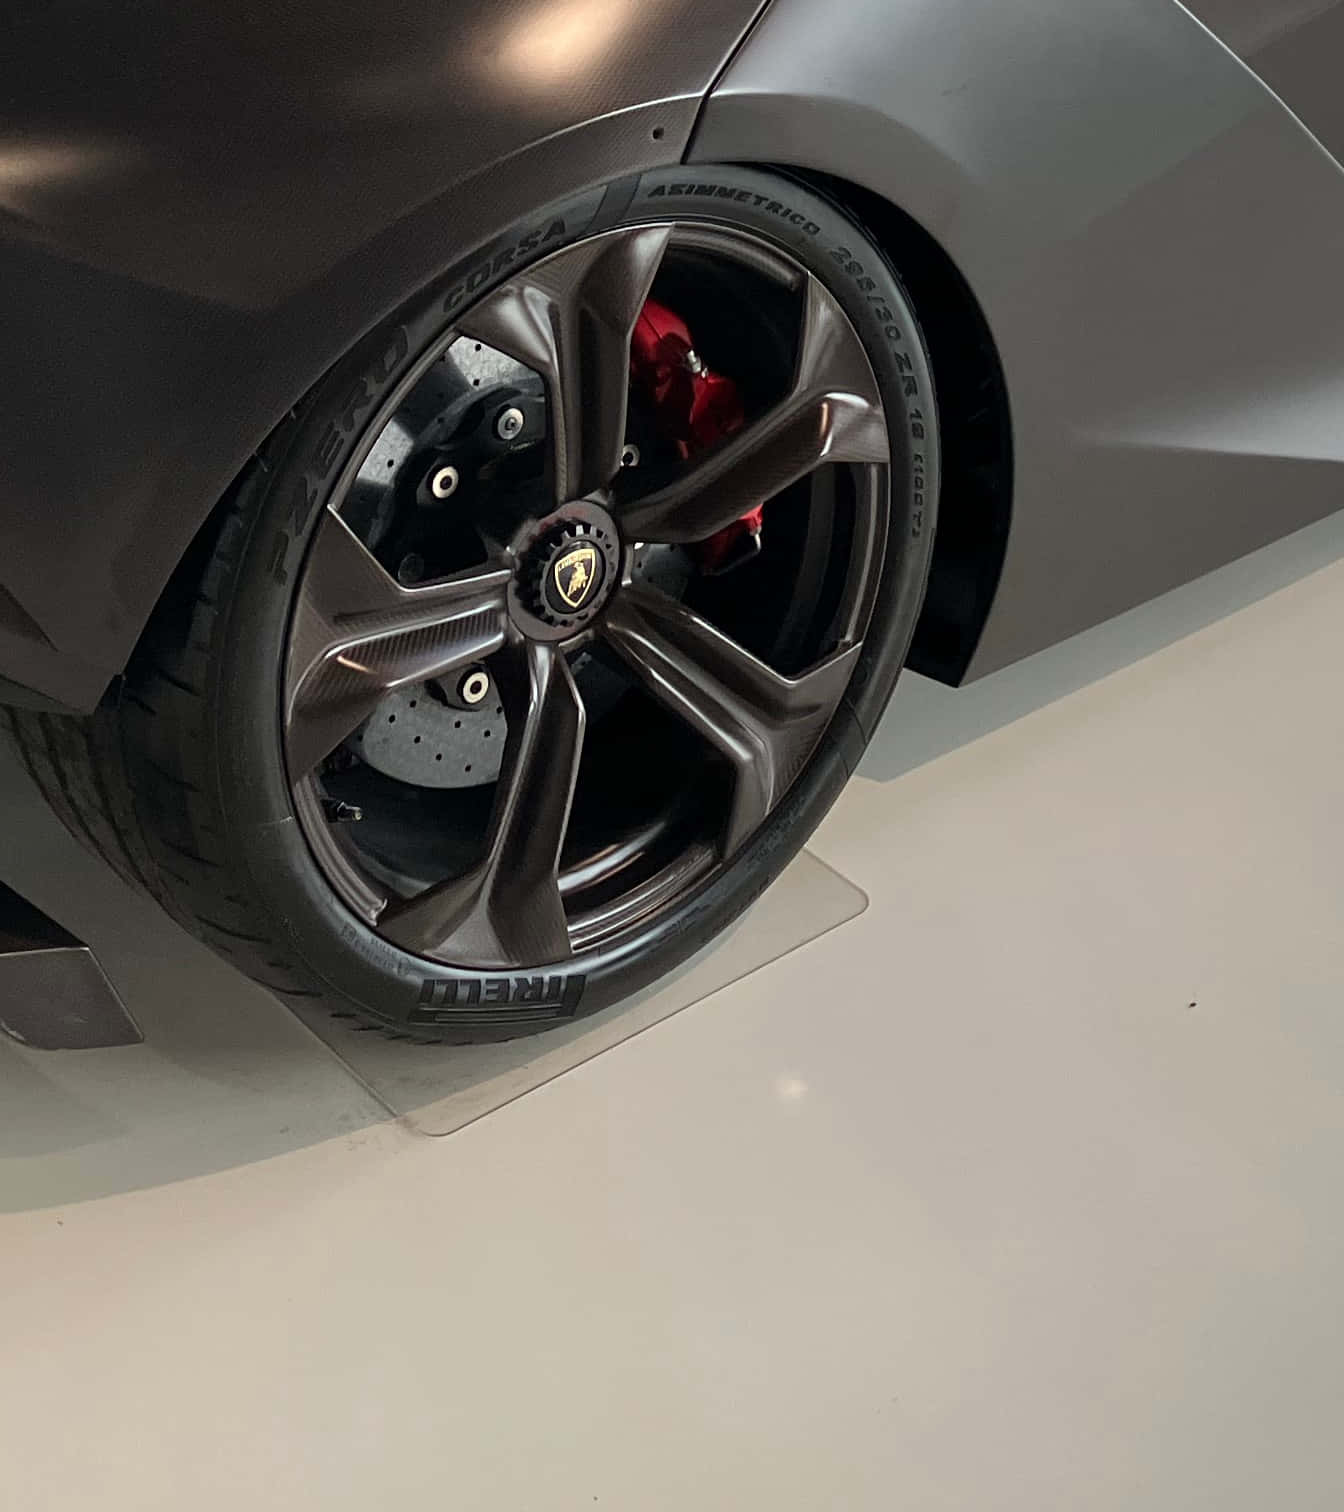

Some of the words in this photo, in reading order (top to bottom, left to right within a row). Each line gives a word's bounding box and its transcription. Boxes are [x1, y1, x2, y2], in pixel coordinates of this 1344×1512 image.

[442, 216, 566, 314] CORSA
[647, 183, 821, 236] ASIMMETRICO
[894, 351, 918, 398] ZR
[410, 974, 587, 1024] PIRELLI
